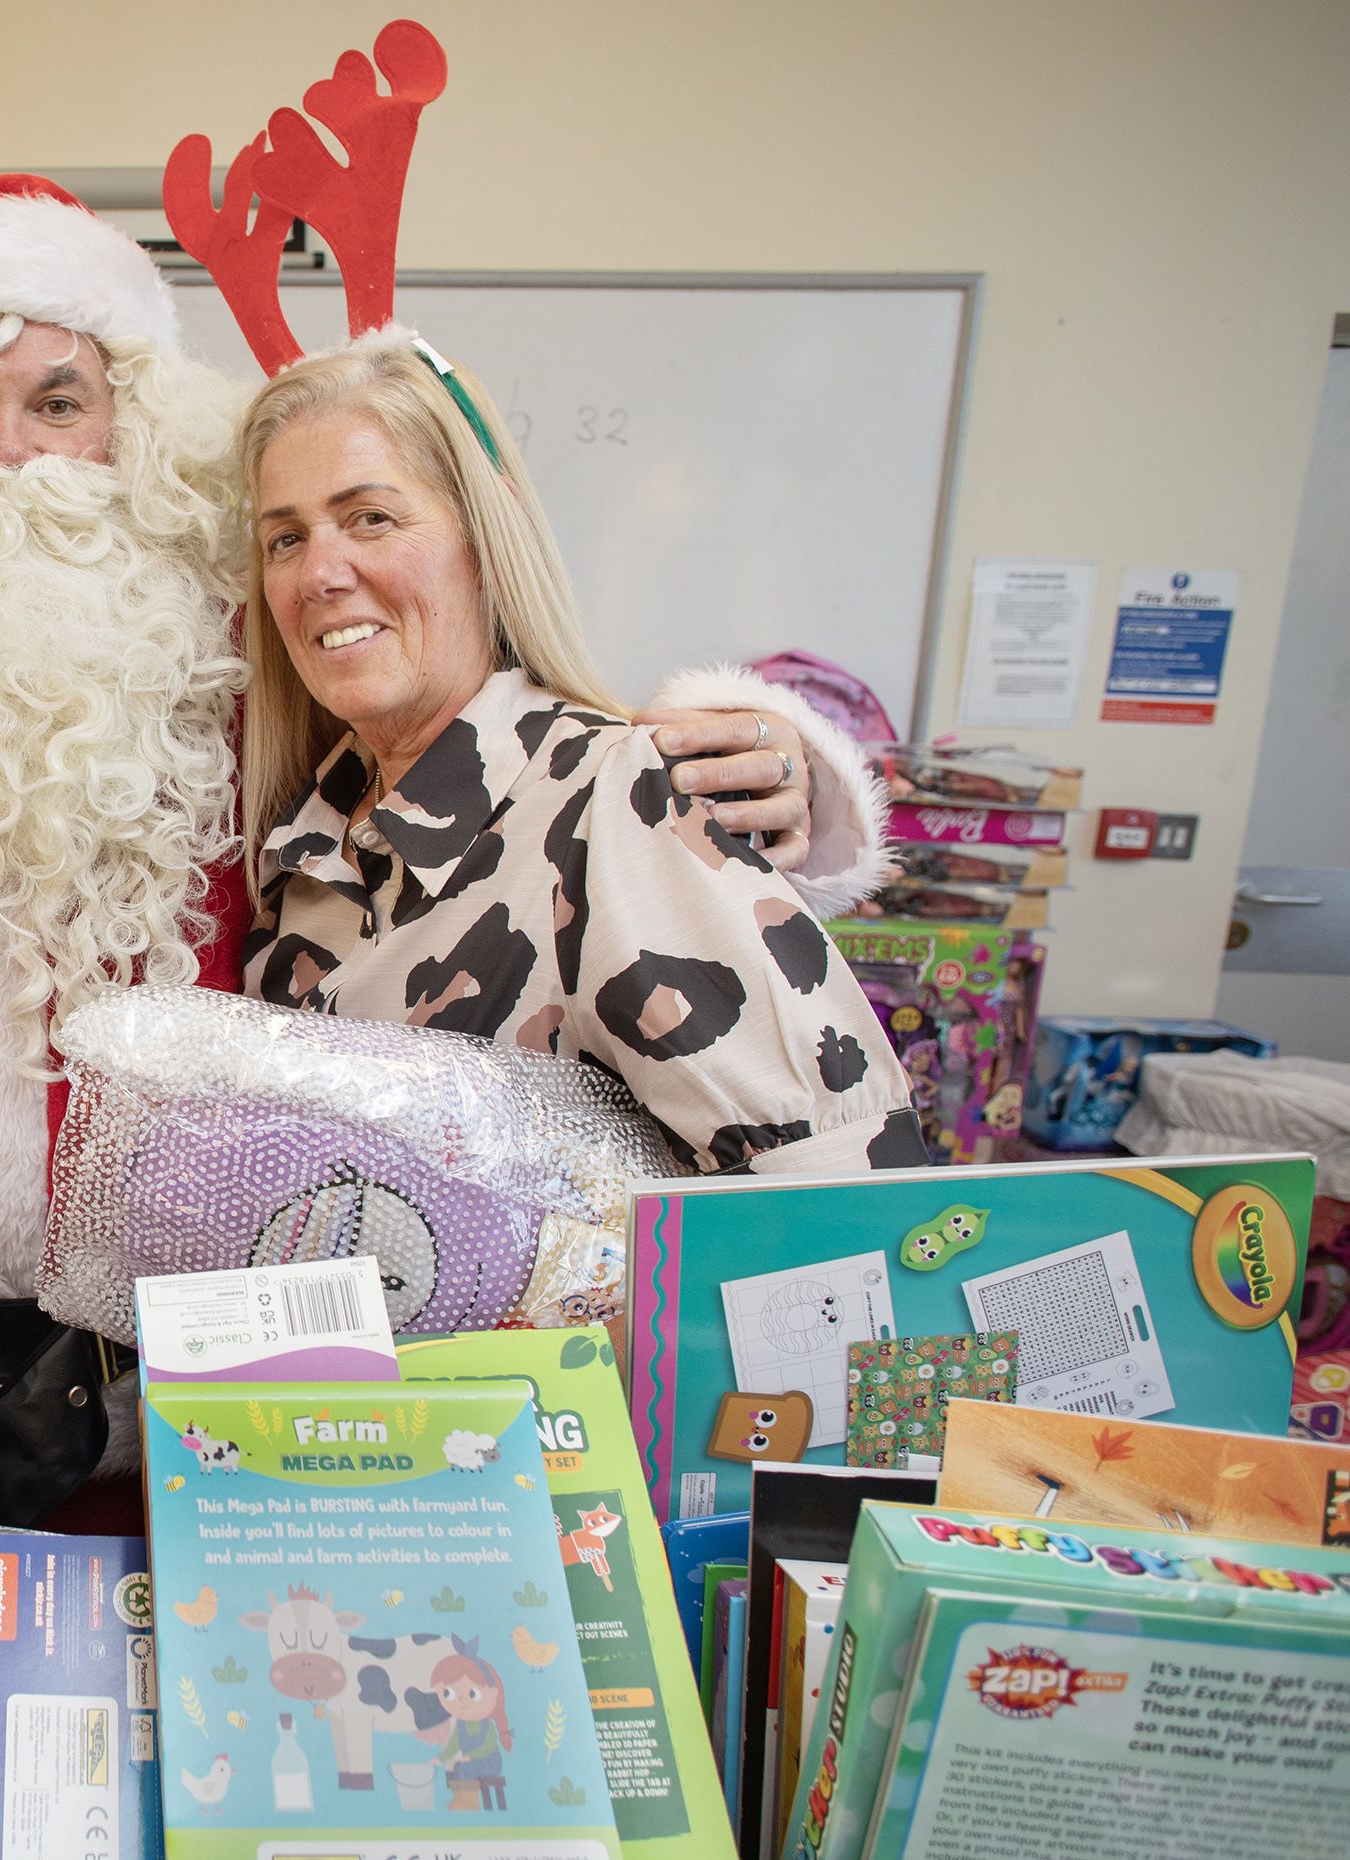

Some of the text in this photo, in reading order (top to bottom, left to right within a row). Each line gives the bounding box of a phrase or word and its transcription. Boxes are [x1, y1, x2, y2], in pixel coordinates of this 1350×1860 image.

[575, 404, 630, 447] 32
[1135, 590, 1164, 604] Fire
[1239, 1204, 1276, 1306] Crayola
[208, 1332, 252, 1346] Classic
[292, 1414, 389, 1446] Farm
[280, 1453, 415, 1473] MEGA PAD
[556, 1456, 577, 1468] SET
[196, 1496, 510, 1517] This Mega Pad is BURSTING with farmyard fun.
[199, 1521, 513, 1542] Inside you'll find lots of pictures to colour in
[914, 1514, 1098, 1565] Puffy
[205, 1547, 514, 1567] and animal and farm activities to complete.
[584, 1621, 623, 1631] CREATIVITY
[585, 1630, 629, 1640] OUT SCENES
[139, 1662, 150, 1706] PlanetMark
[830, 1632, 856, 1733] STUDIO
[1150, 1661, 1306, 1691] It's time to get
[600, 1694, 630, 1703] SCENE
[1144, 1681, 1190, 1699] Zap!
[1261, 1693, 1316, 1713] Puffy
[610, 1719, 656, 1729] CREATION OF
[1141, 1699, 1309, 1729] These delightful
[604, 1730, 649, 1740] BEAUTIFULLY
[633, 1739, 658, 1748] PAPER
[1134, 1720, 1318, 1750] so much joy and
[616, 1749, 652, 1759] DISCOVER
[954, 1743, 1141, 1777] This kit includes everything
[1129, 1739, 1165, 1754] can
[1170, 1742, 1226, 1760] make
[1231, 1749, 1278, 1766] your
[607, 1758, 664, 1769] FUN BY MAKING
[607, 1768, 650, 1778] RABBIT HOP
[949, 1759, 1050, 1780] very own puffy
[610, 1777, 671, 1788] SLIDE THE TAB AT
[1029, 1780, 1059, 1793] plus
[625, 1789, 636, 1798] UP
[942, 1785, 1085, 1811] instructions guide
[939, 1797, 1060, 1822] from the included
